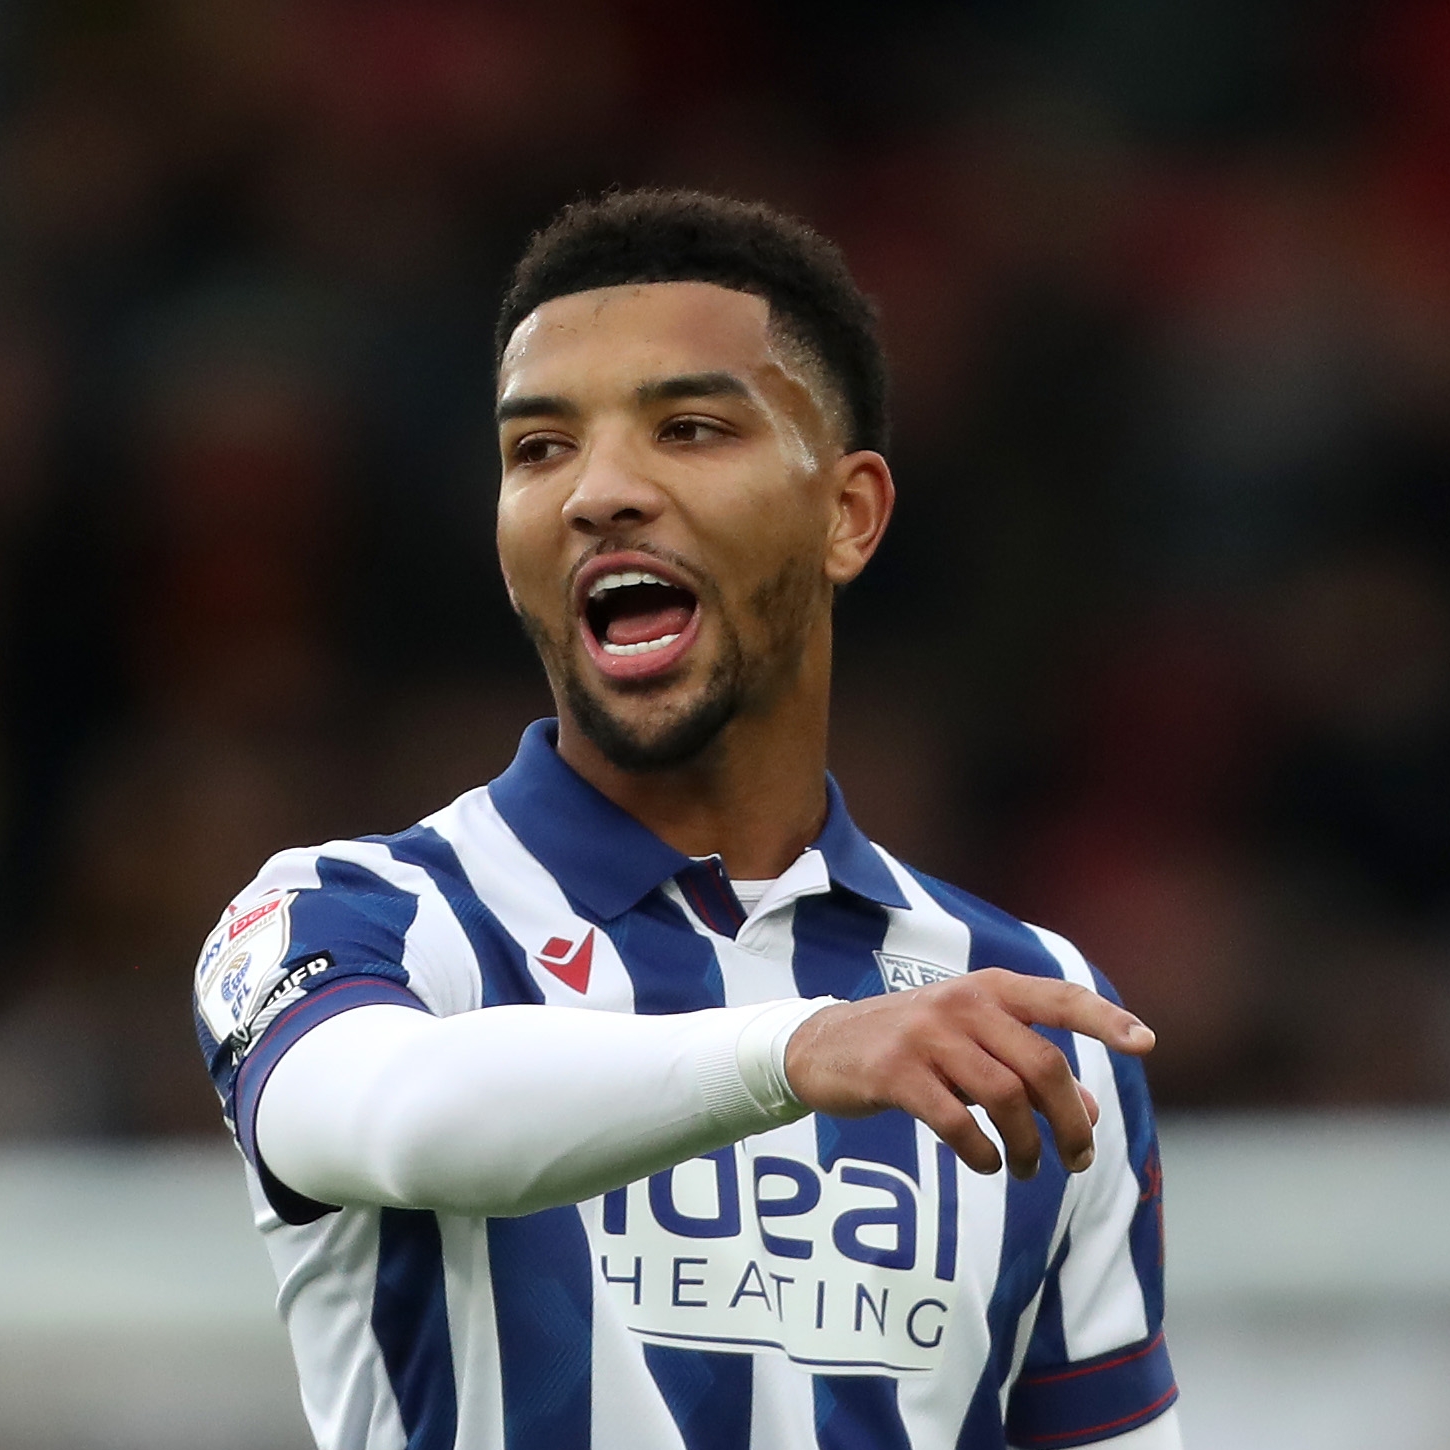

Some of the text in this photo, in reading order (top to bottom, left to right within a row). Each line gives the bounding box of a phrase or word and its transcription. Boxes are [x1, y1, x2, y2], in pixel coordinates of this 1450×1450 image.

[199, 902, 276, 980] sky bet
[231, 982, 252, 1021] EFL
[601, 1255, 949, 1349] HEATING
